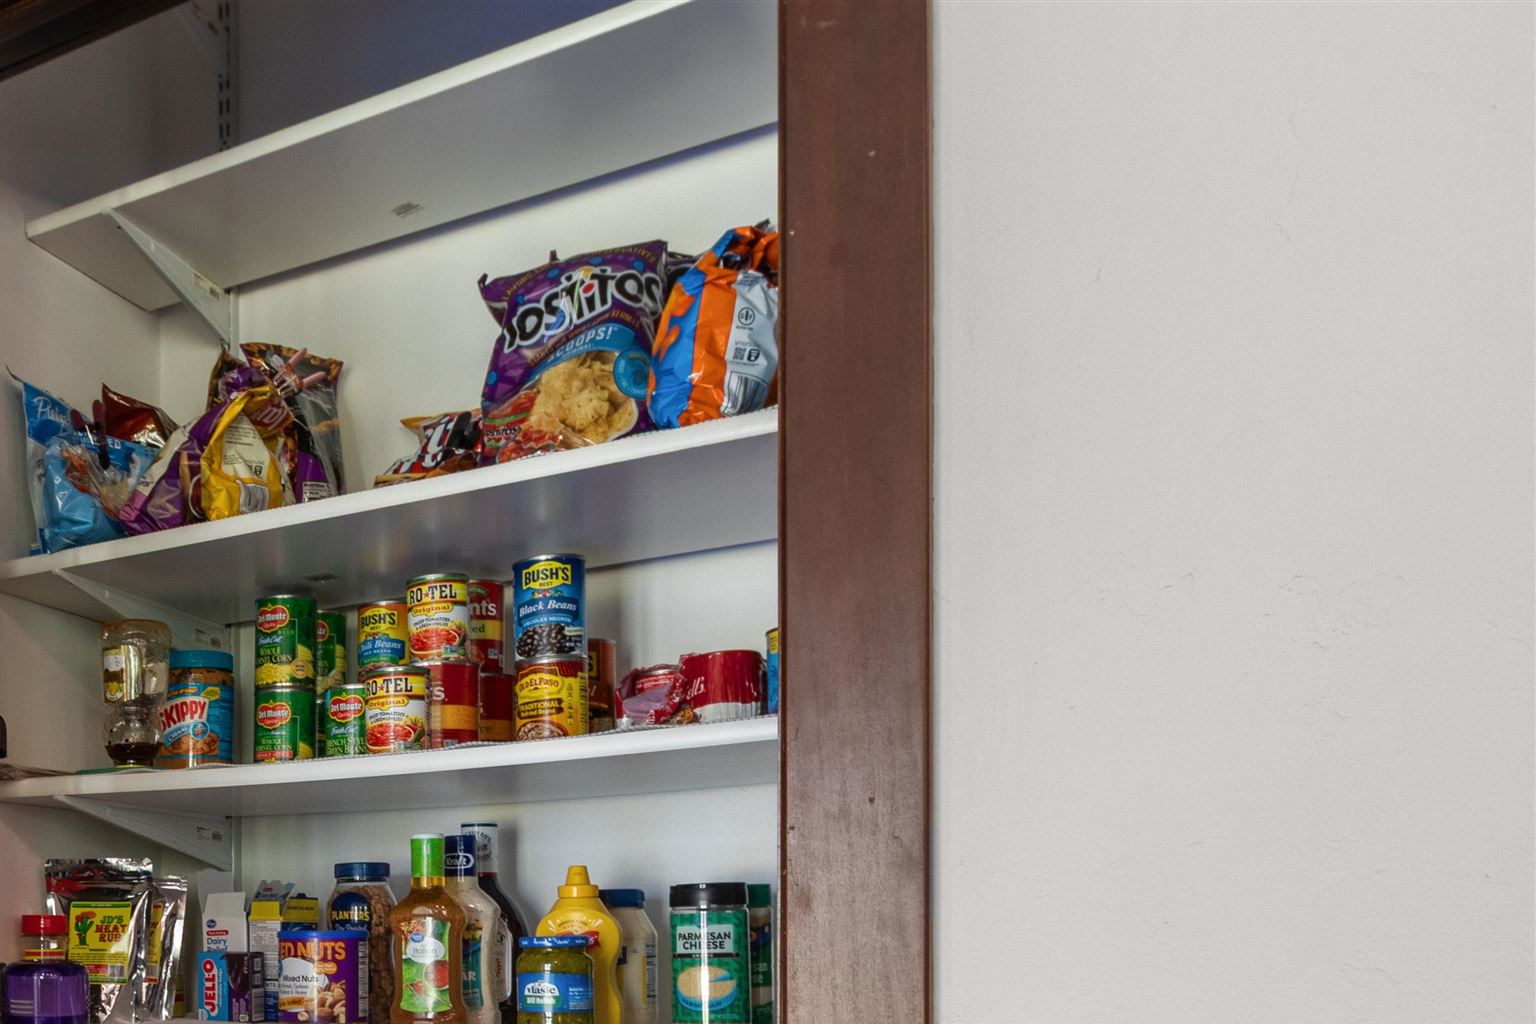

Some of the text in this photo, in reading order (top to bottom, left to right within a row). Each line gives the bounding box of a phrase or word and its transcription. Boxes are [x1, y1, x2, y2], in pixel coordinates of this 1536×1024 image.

[547, 325, 613, 362] SCOOPS!
[524, 566, 570, 588] BUSH'S
[413, 604, 451, 614] Original
[519, 599, 577, 618] Black Beans
[360, 611, 396, 629] BUSH'S
[374, 639, 402, 650] Beans
[330, 701, 362, 712] Del Monte
[369, 697, 406, 708] Original
[520, 700, 560, 712] TRADITIONAL
[159, 700, 207, 730] SKIPPY
[258, 708, 289, 719] Del Monte
[446, 854, 468, 867] Kraft
[100, 915, 124, 925] JD'S
[332, 910, 370, 922] PLANTERS
[95, 924, 128, 934] MEAT
[99, 933, 122, 943] RUB
[678, 931, 732, 941] PARMESAN
[207, 937, 228, 947] Dairy
[682, 940, 726, 951] CHEESE
[297, 941, 347, 961] NUTS
[282, 974, 319, 983] Mixed Nuts
